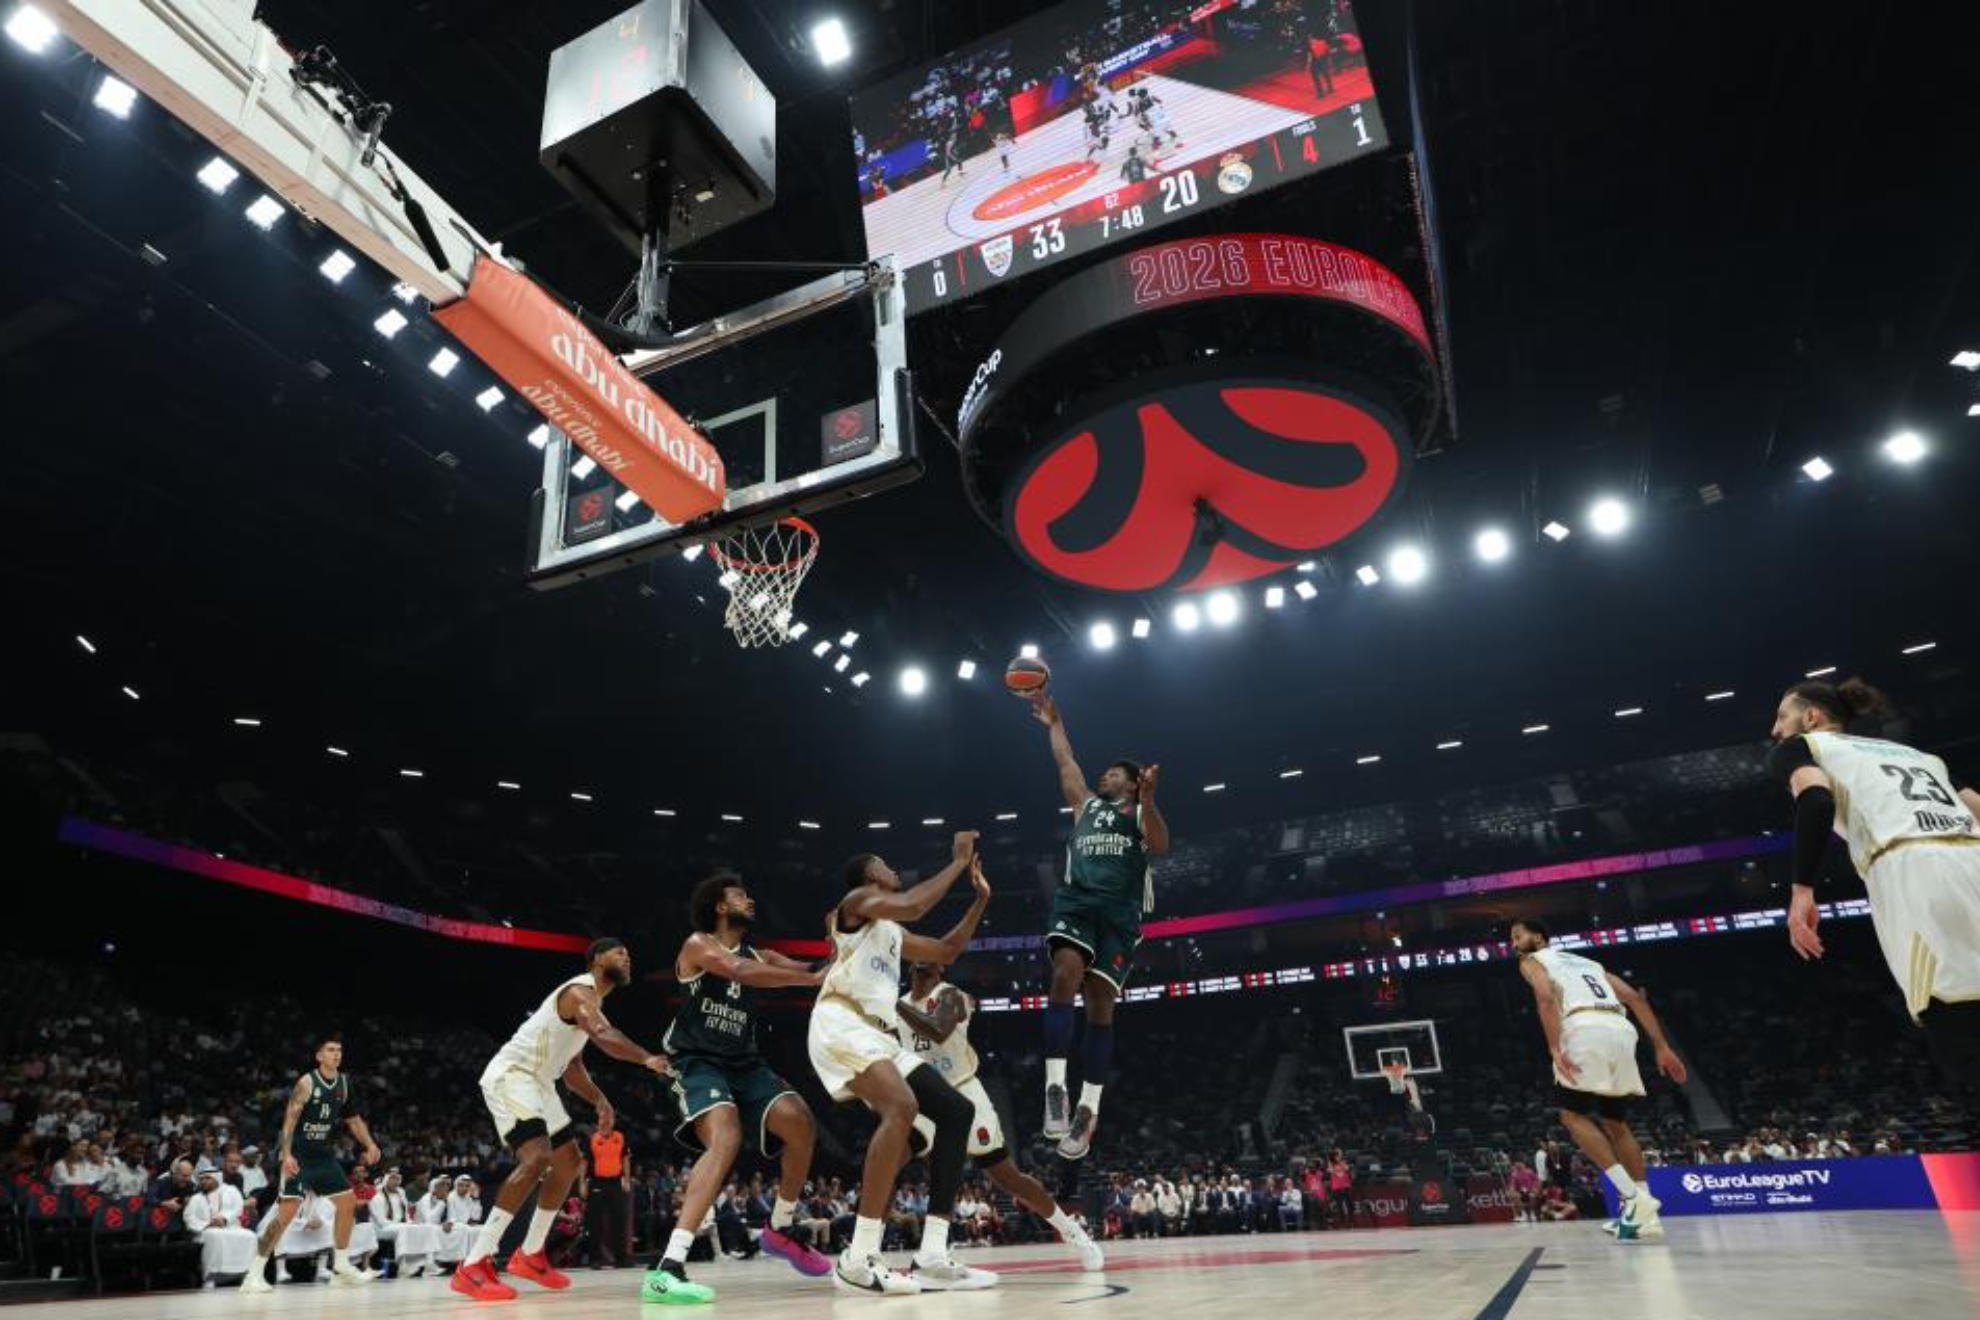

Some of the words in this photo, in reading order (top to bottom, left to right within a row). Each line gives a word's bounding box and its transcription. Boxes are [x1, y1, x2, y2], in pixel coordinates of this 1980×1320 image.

[1353, 118, 1371, 146] 1
[1303, 135, 1319, 165] 4
[1160, 169, 1198, 214] 20
[1099, 204, 1144, 238] 7:48
[1029, 219, 1065, 259] 33
[933, 271, 947, 297] 0
[1131, 239, 1250, 304] 2026
[552, 333, 619, 409] abu
[625, 398, 717, 490] dhabi
[521, 386, 569, 421] abu
[564, 421, 633, 470] dhabi
[1880, 765, 1956, 807] 23
[1093, 810, 1115, 828] 24
[1077, 832, 1132, 849] Emirates
[1582, 974, 1607, 998] 6
[1704, 1170, 1830, 1189] EuroLeagueTV
